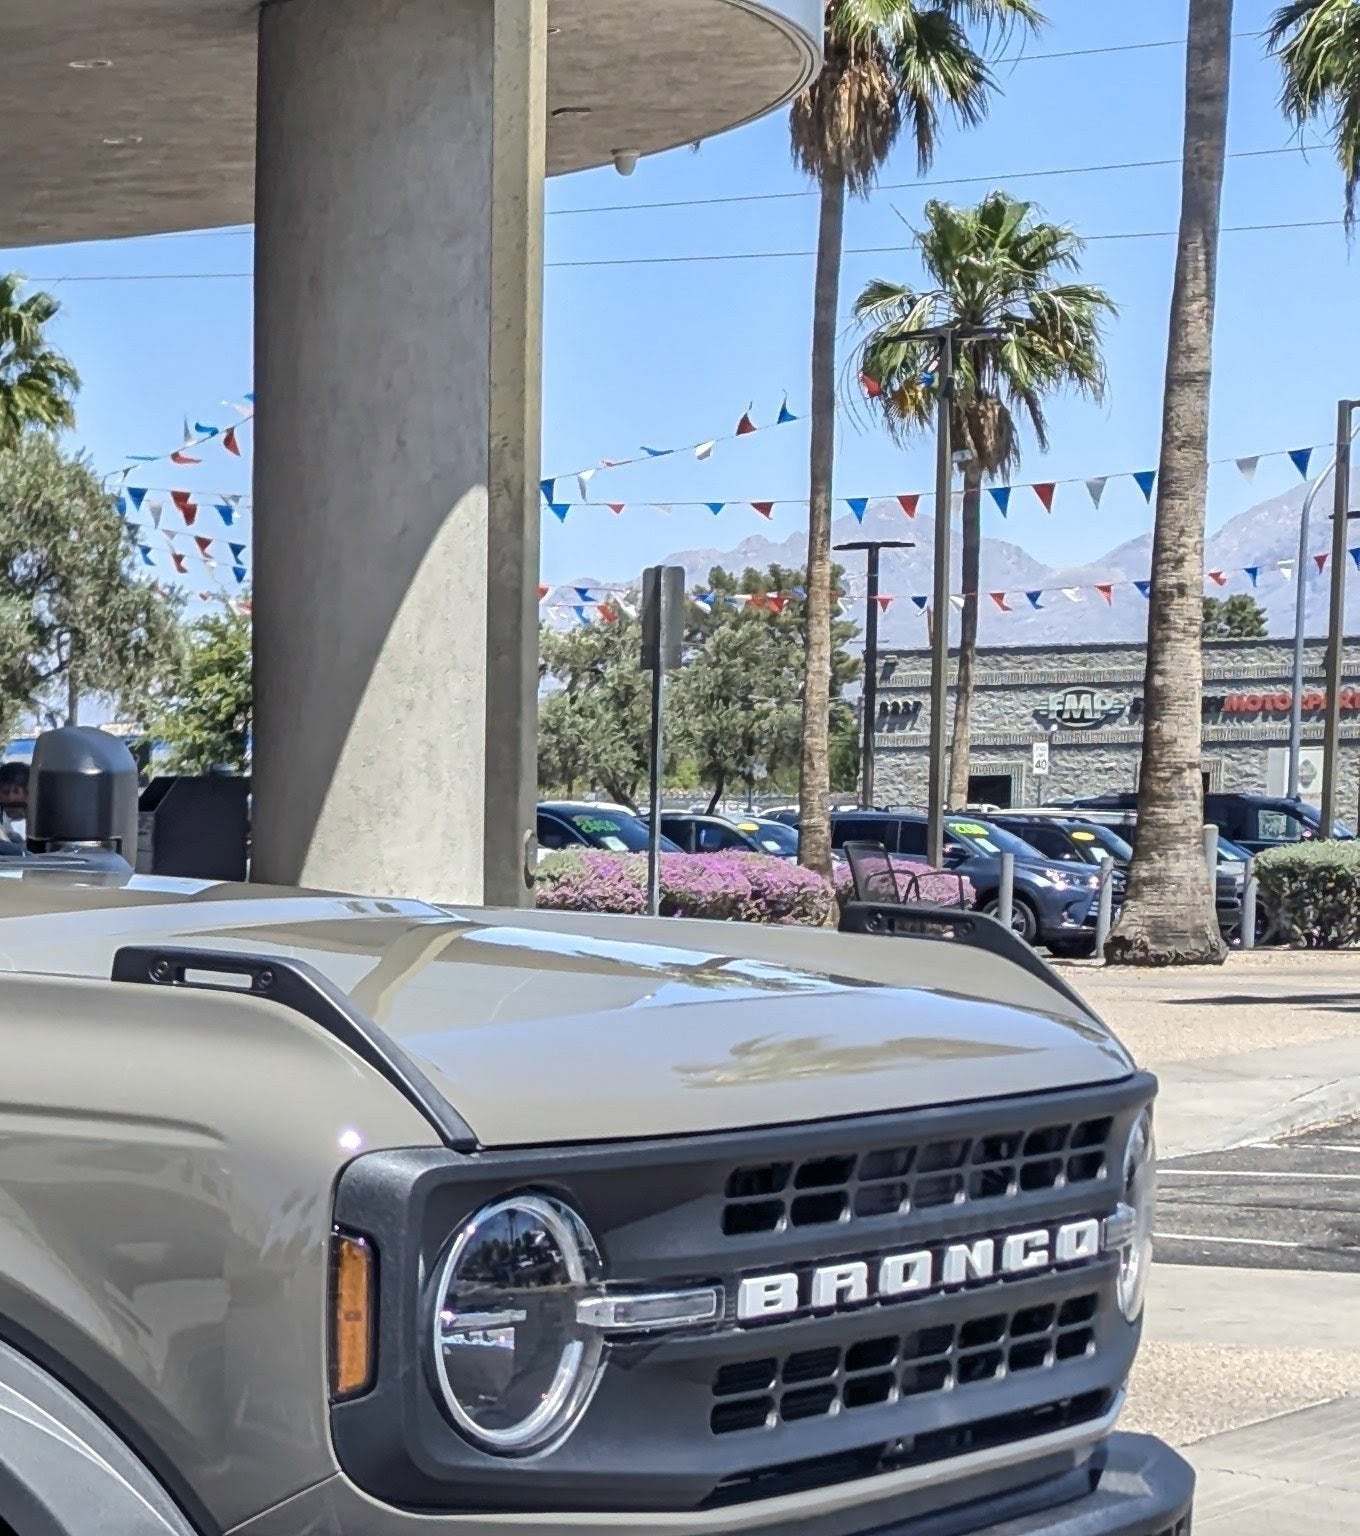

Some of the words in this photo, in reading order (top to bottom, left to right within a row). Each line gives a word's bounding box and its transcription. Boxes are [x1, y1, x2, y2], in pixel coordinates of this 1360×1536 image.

[1048, 693, 1114, 719] FMP
[1035, 759, 1047, 770] 40
[736, 1218, 1101, 1321] BRONCO
